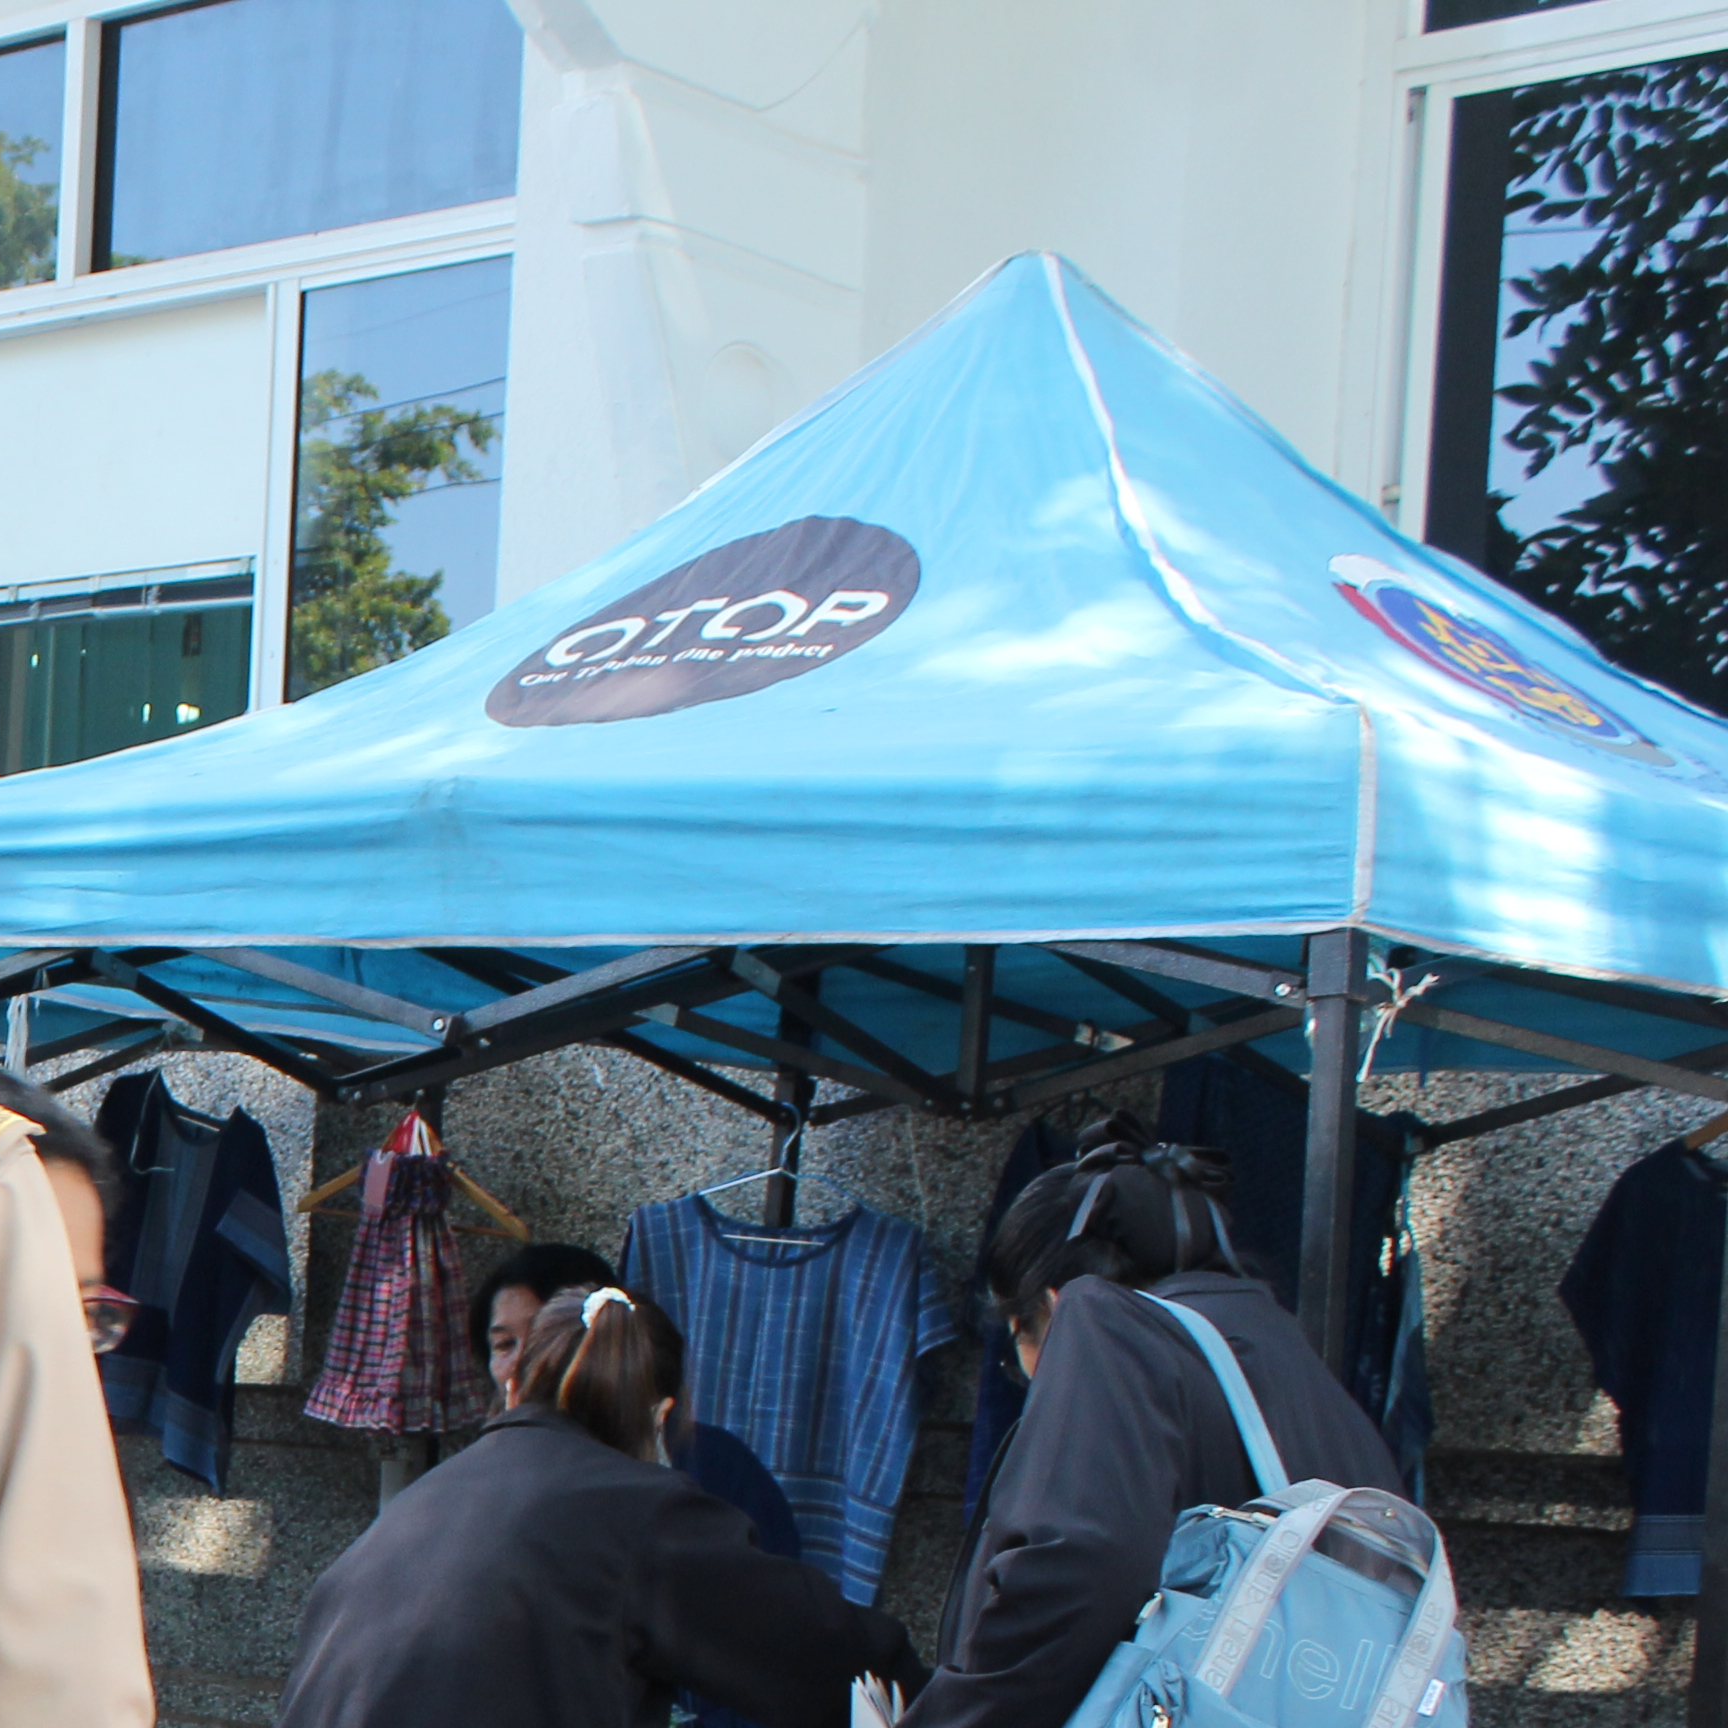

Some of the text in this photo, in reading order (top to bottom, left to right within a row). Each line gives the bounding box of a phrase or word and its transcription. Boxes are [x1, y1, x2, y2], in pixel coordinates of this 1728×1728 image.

[545, 588, 891, 667] OTOP
[519, 669, 568, 688] One
[728, 641, 836, 663] product
